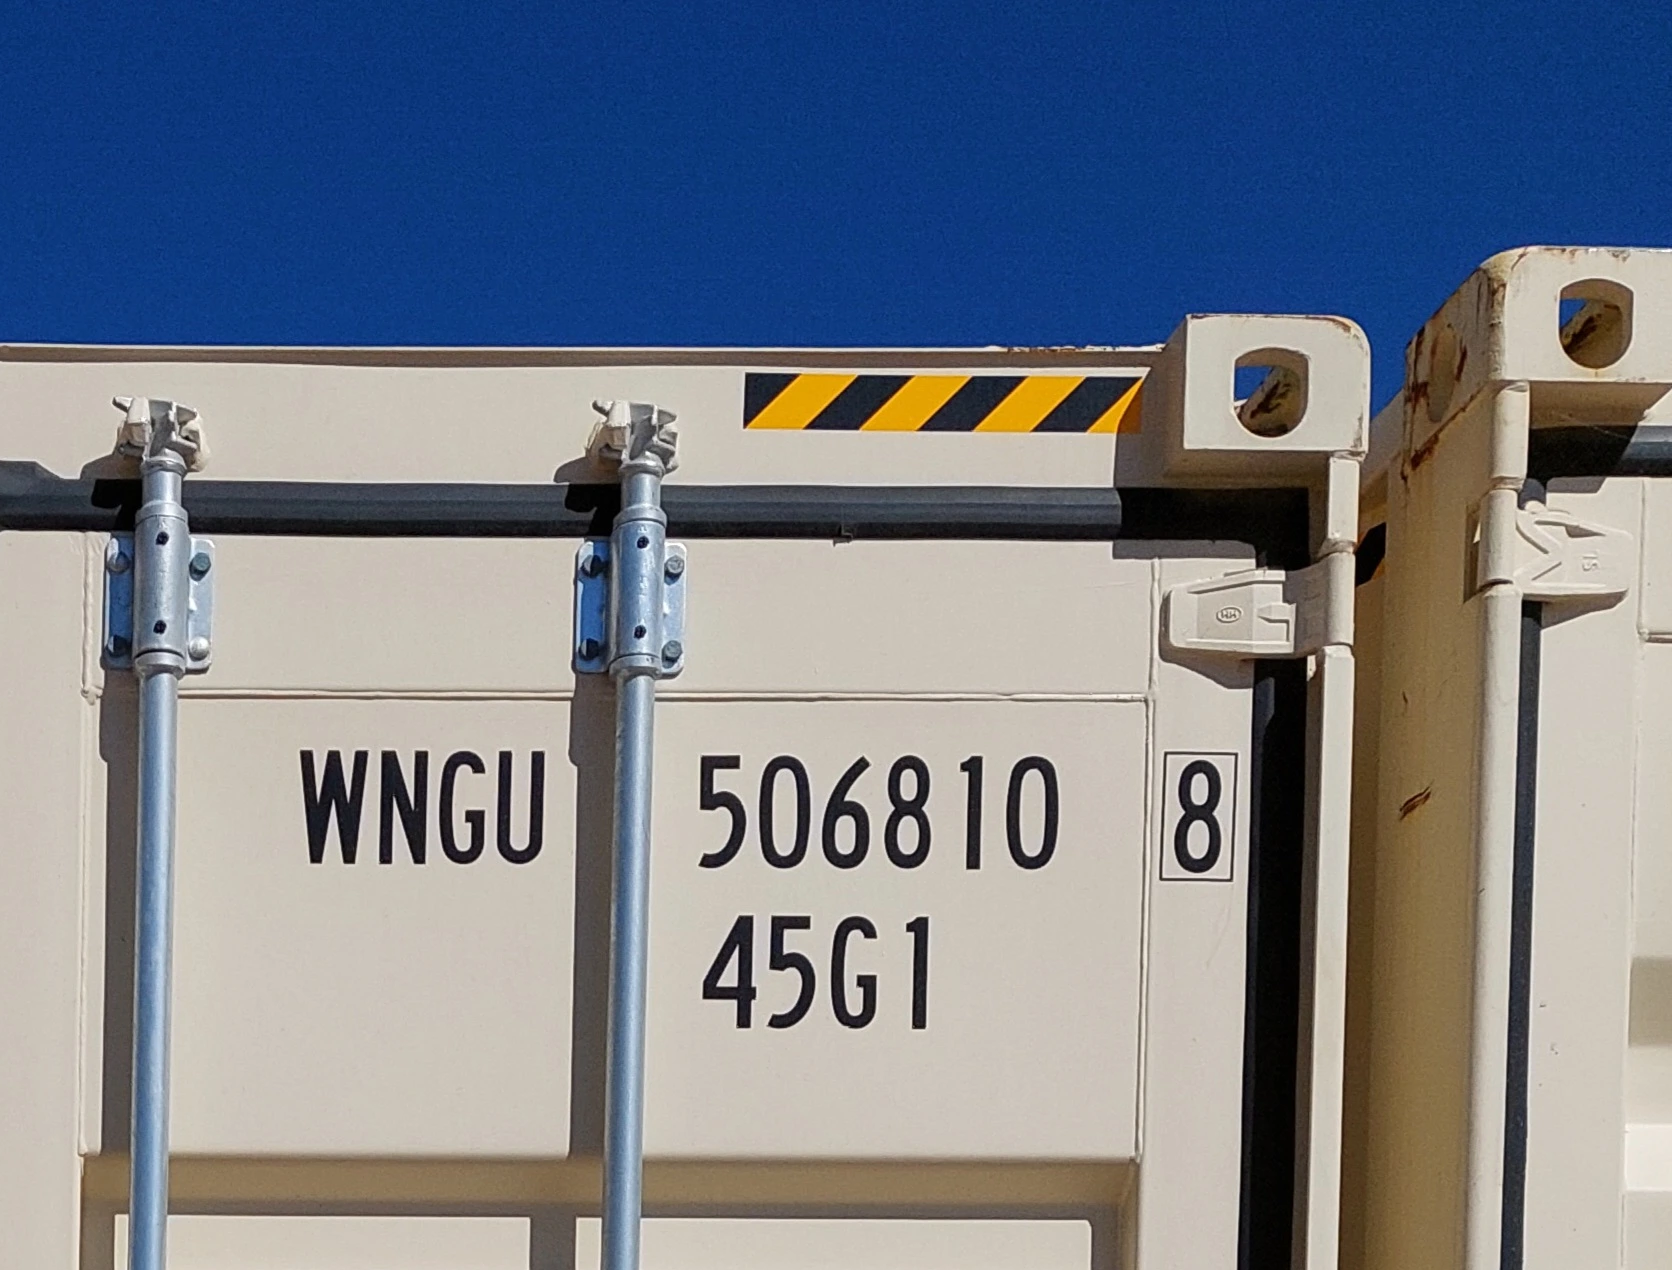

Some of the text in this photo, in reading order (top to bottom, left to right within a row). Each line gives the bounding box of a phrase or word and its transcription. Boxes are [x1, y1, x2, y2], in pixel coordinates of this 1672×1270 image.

[300, 750, 1223, 873] WNGU 506810 8
[703, 916, 929, 1029] 45G1
